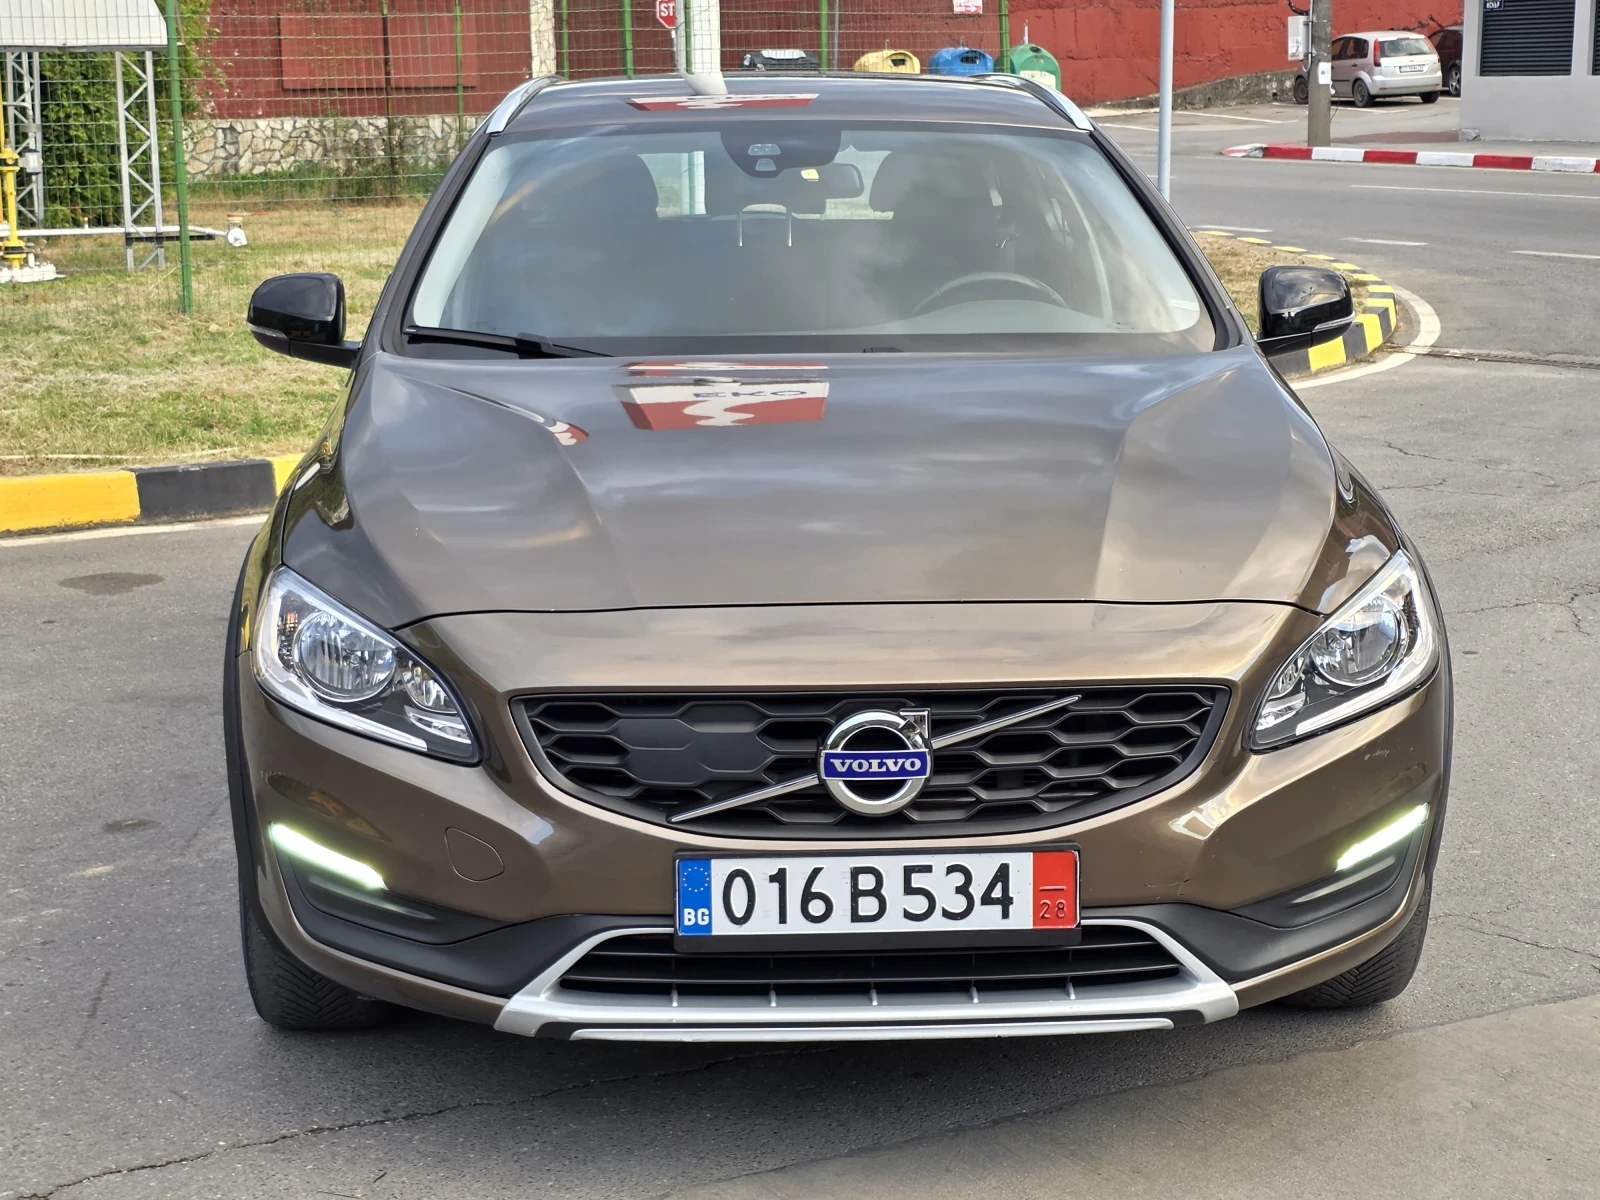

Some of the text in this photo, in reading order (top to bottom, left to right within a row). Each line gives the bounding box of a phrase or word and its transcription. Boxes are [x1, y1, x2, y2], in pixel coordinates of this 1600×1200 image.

[660, 3, 675, 16] ST
[830, 758, 921, 772] VOLVO
[722, 862, 1014, 926] 016 B 534
[683, 908, 710, 926] BG
[1039, 899, 1067, 919] 28
